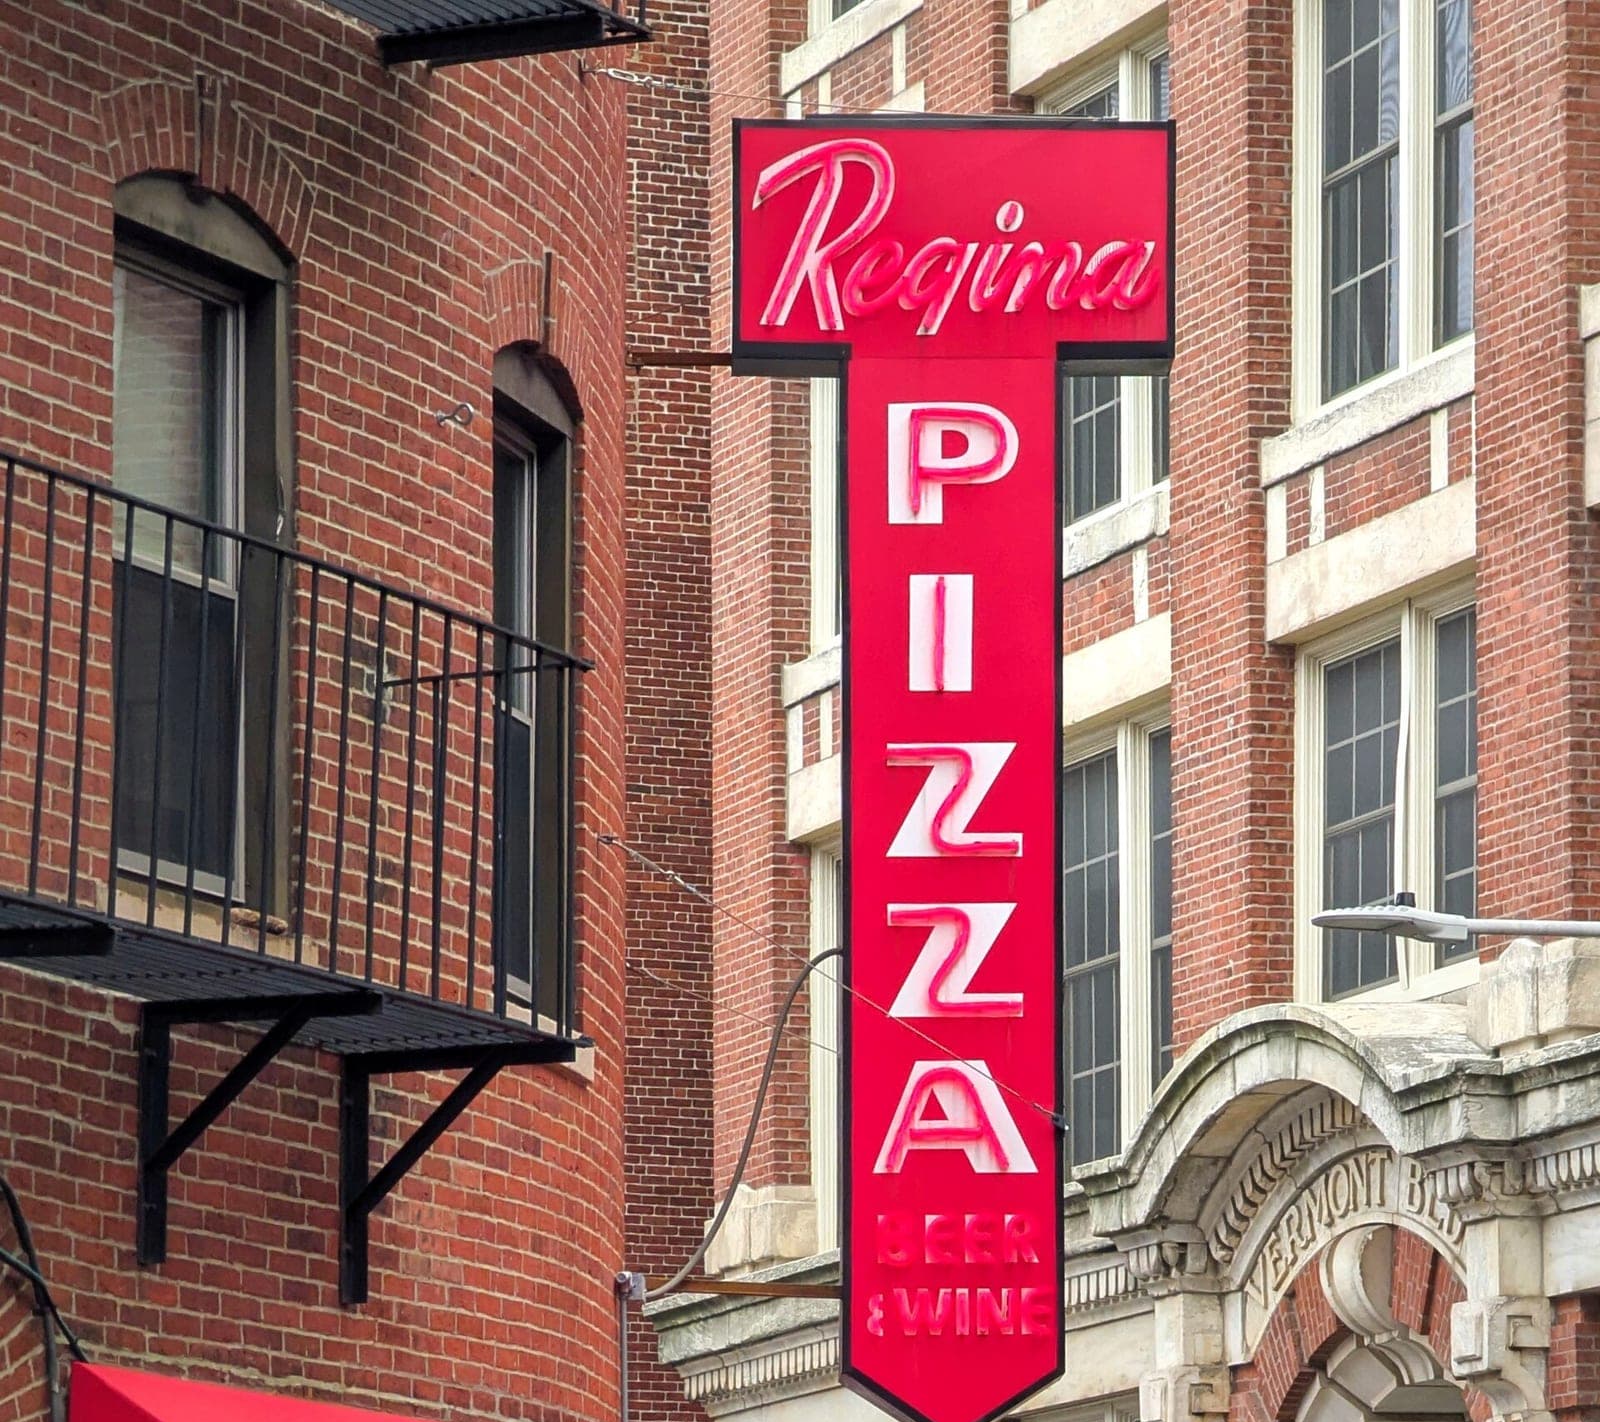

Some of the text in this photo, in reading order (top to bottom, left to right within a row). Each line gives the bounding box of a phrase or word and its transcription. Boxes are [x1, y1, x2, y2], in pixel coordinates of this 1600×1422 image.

[751, 137, 1159, 336] Regina
[872, 402, 1039, 1174] PIZZA
[877, 1213, 1042, 1266] BEER
[1245, 1149, 1394, 1310] VERMONT
[892, 1286, 1058, 1337] WINE
